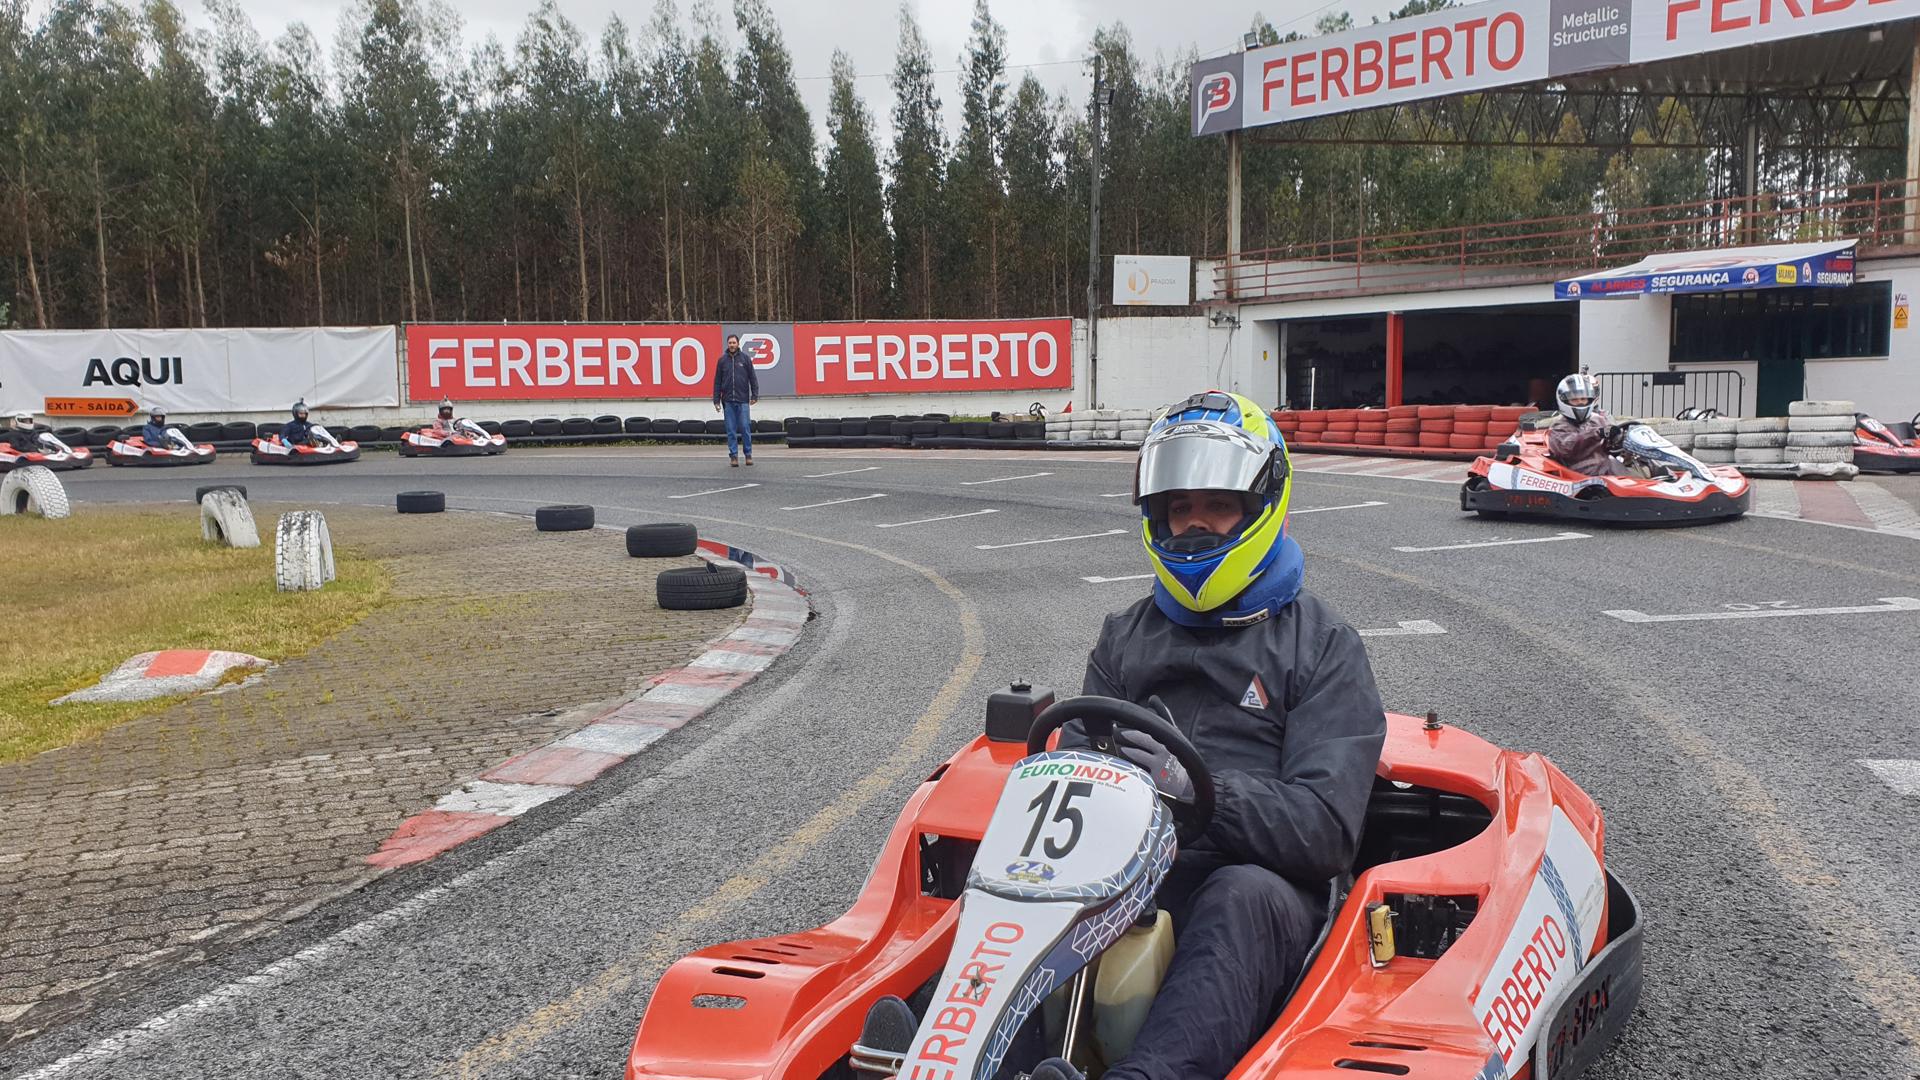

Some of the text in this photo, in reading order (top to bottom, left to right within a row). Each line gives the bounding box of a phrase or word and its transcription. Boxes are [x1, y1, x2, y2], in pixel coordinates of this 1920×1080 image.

[1562, 6, 1619, 30] Metallic
[1553, 23, 1628, 47] Structures
[1264, 12, 1526, 112] FERBERTO
[1650, 271, 1730, 288] SEGURANÇA
[1816, 271, 1854, 287] SEGURANÇA
[428, 336, 706, 387] FERBERTO
[814, 332, 1059, 382] FERBERTO
[82, 357, 183, 388] AQUI
[47, 402, 75, 411] EXIT
[88, 400, 124, 411] SAÍDA
[1519, 474, 1570, 495] FERBERTO
[1018, 763, 1129, 785] EUROINDY
[1020, 780, 1094, 860] 15
